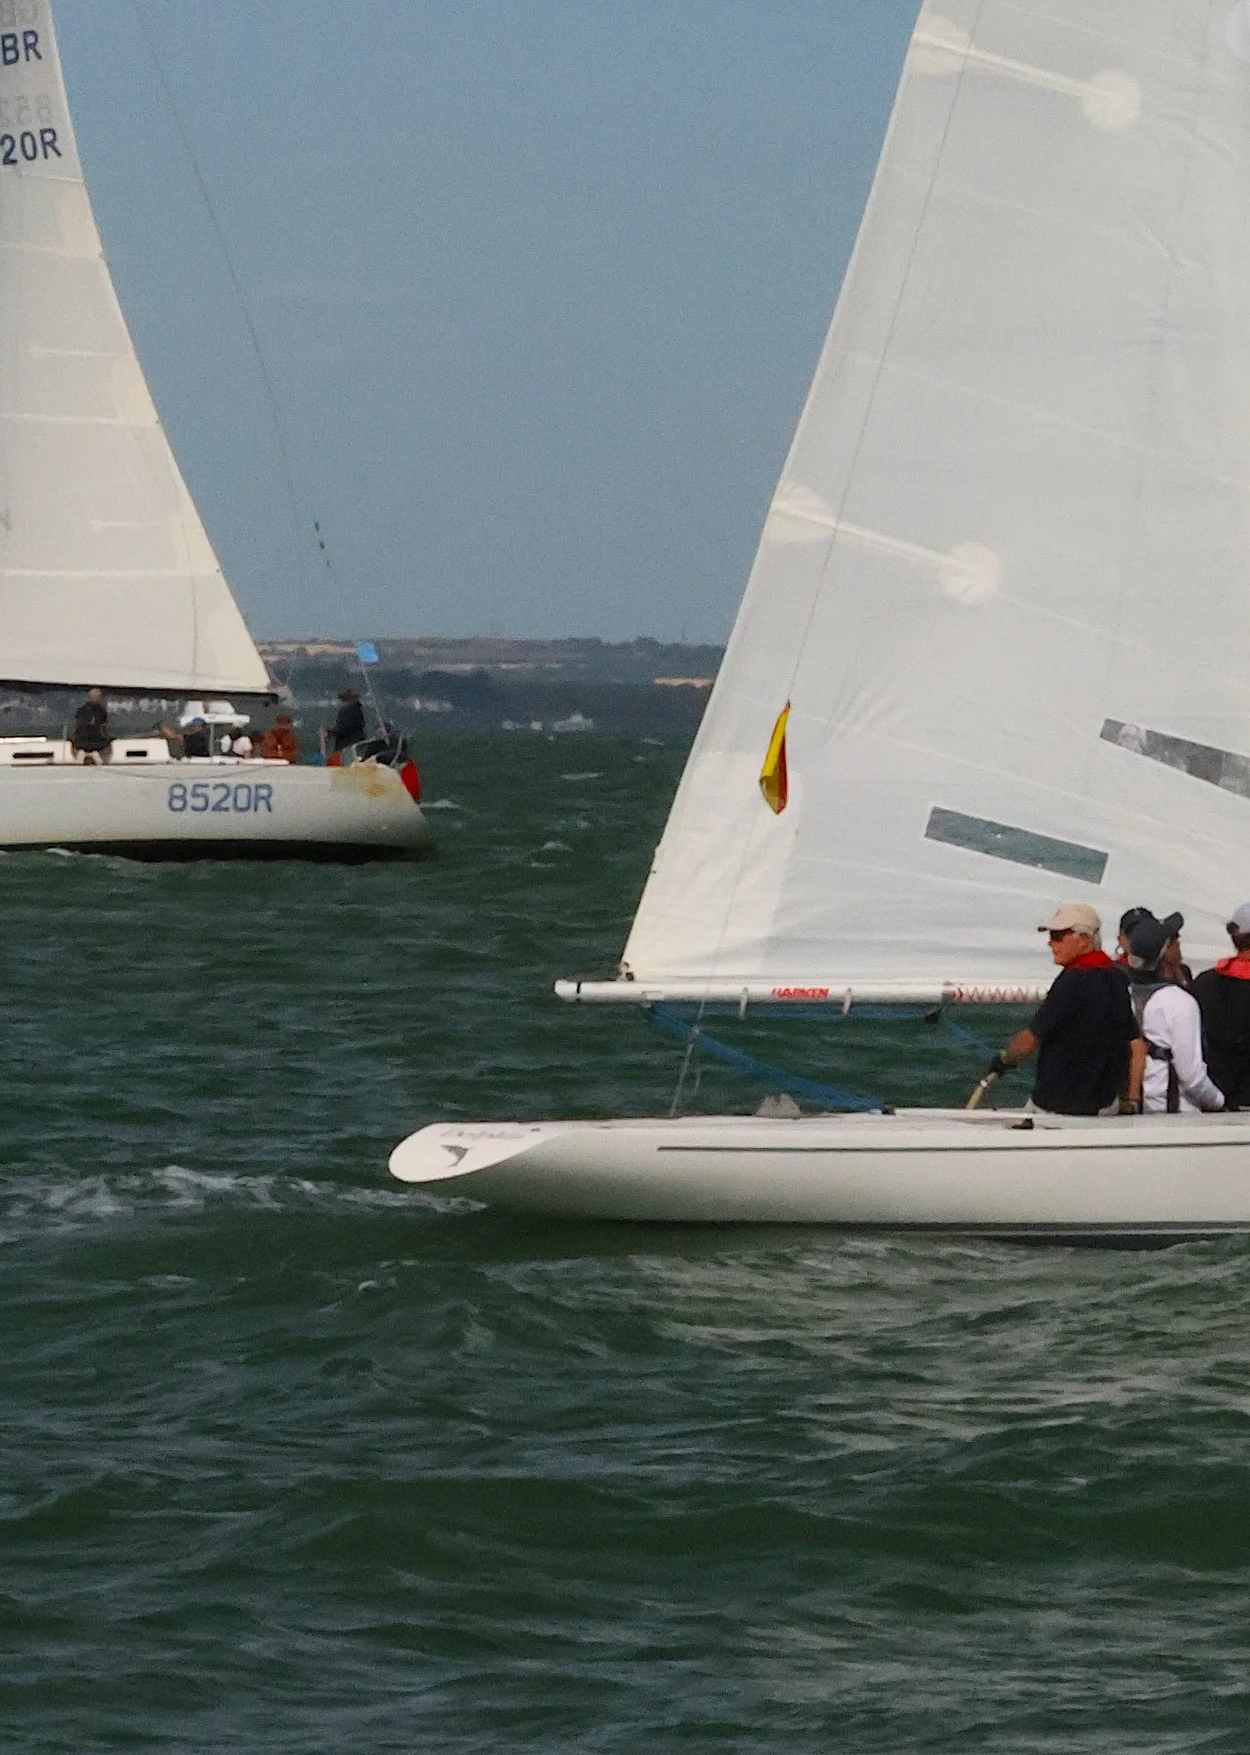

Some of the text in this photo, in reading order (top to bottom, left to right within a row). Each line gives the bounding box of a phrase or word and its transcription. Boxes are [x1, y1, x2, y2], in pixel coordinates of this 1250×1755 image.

[0, 30, 42, 66] BR
[0, 127, 62, 166] 20R
[168, 783, 273, 813] 8520R
